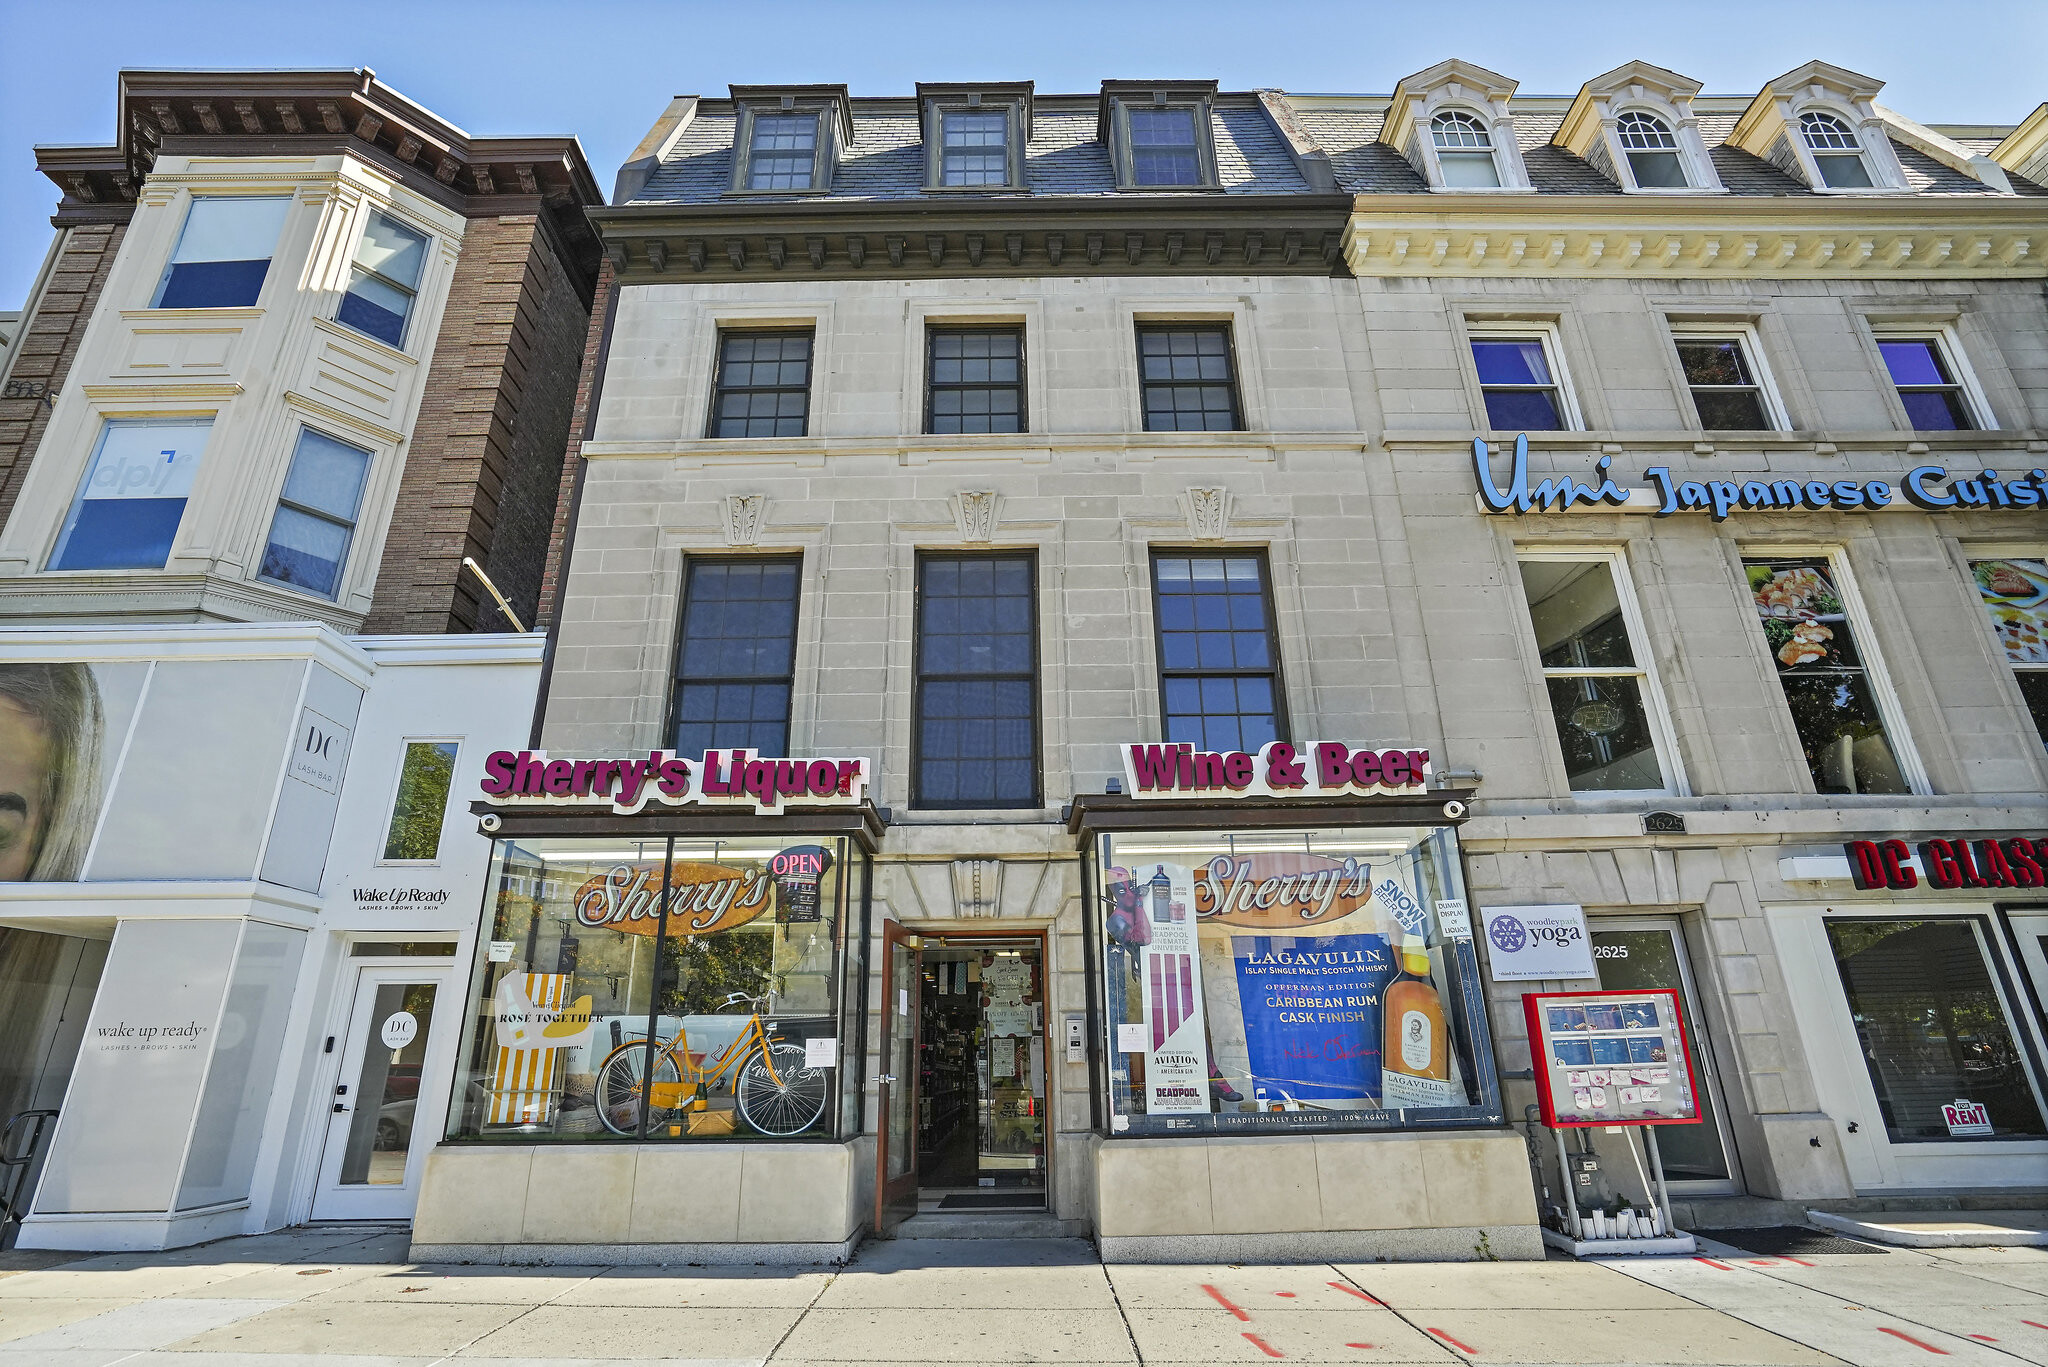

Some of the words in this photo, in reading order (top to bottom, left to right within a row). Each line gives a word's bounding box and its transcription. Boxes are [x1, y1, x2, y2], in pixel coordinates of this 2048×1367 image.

[1471, 432, 1630, 515] Umi
[1643, 467, 1892, 523] Japanese
[305, 726, 339, 761] DC
[297, 762, 316, 775] LASH
[318, 771, 332, 782] BAR
[1130, 743, 1254, 791] Wine
[1265, 742, 1309, 789] &
[1314, 742, 1429, 788] Beer
[480, 750, 690, 806] Sherry's
[701, 749, 862, 807] Liquor
[1649, 818, 1683, 830] 2625
[772, 853, 823, 875] OPEN
[1844, 839, 1918, 890] DC
[1917, 837, 2048, 889] GLAS
[353, 888, 388, 902] Wake
[389, 888, 408, 904] Up
[408, 888, 451, 904] Ready
[577, 865, 770, 928] Sherry's
[1194, 855, 1371, 919] Sherry's
[1373, 887, 1398, 913] BEER
[1380, 879, 1425, 922] SNOW
[1529, 926, 1582, 947] yoga
[1247, 950, 1382, 966] LAGAVULIN
[1594, 946, 1629, 959] 2625
[1245, 967, 1267, 975] ISLAY
[1269, 967, 1297, 975] SINGLE
[1299, 967, 1320, 976] MALT
[1322, 966, 1354, 975] SCOTCH
[1355, 964, 1388, 973] WHISKY
[1328, 982, 1375, 991] EDITION
[1266, 997, 1344, 1009] CARIBBEAN
[1347, 995, 1378, 1007] RUM
[390, 1020, 411, 1033] DC
[500, 1012, 531, 1023] ROSÉ
[536, 1014, 604, 1023] TOGETHER
[1279, 1012, 1316, 1023] CASK
[1317, 1011, 1365, 1024] FINISH
[98, 1021, 135, 1037] wake
[138, 1026, 158, 1042] up
[1154, 1055, 1198, 1065] AVIATION
[1156, 1088, 1199, 1097] DEADPOOL
[1388, 1074, 1444, 1092] LAGAVULIN
[1364, 1113, 1390, 1121] AGAVE
[1945, 1106, 1986, 1126] RENT
